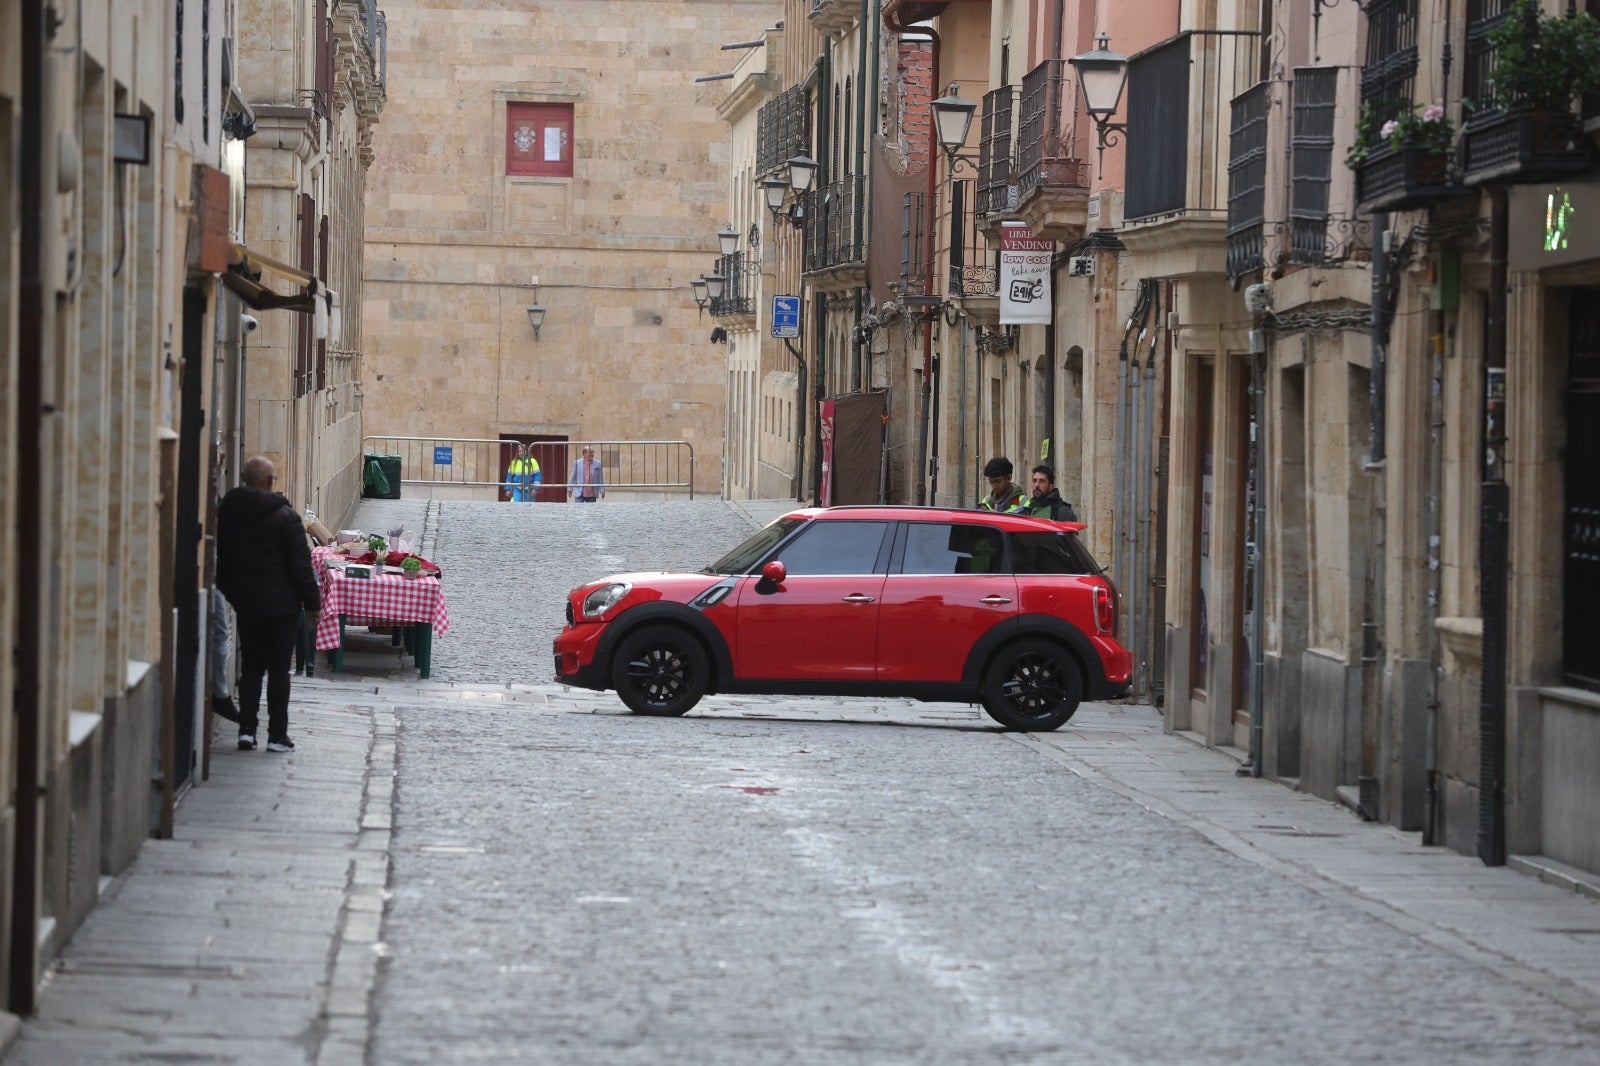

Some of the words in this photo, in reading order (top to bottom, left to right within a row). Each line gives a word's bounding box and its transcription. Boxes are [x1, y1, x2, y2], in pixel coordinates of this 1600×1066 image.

[1009, 230, 1032, 238] LIBRE
[1004, 240, 1052, 250] VENDING
[1003, 253, 1024, 264] low
[1026, 254, 1050, 264] cost
[1011, 264, 1029, 276] take
[1031, 265, 1050, 275] away
[1013, 286, 1032, 300] 24H
